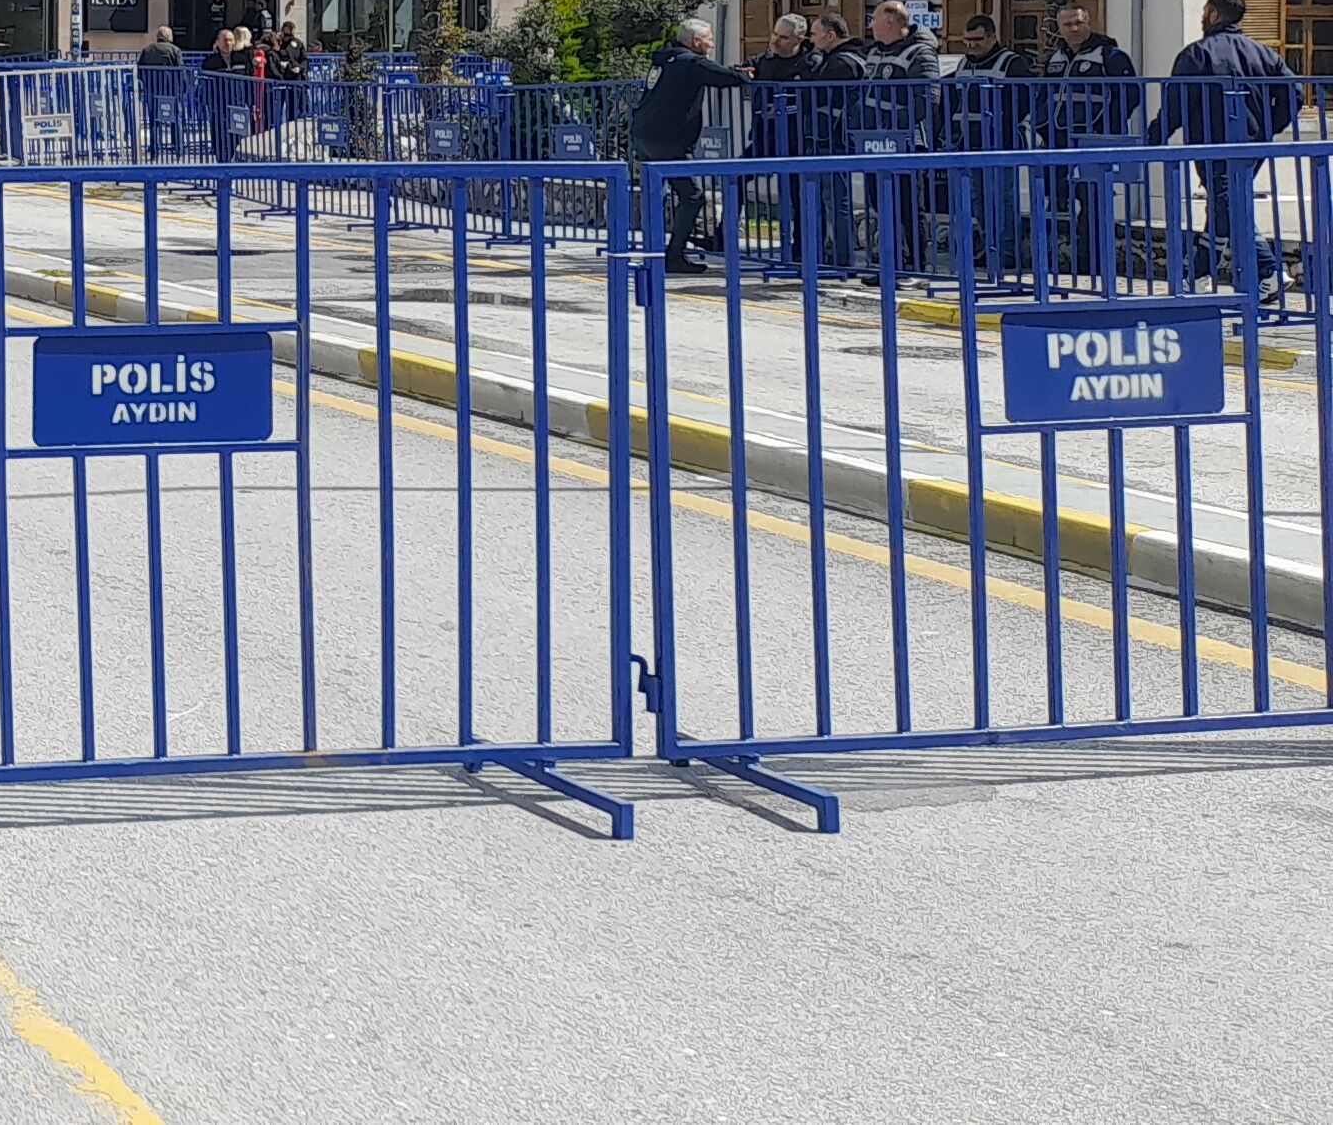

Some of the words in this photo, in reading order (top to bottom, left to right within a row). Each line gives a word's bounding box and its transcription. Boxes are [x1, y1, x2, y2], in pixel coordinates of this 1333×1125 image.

[864, 137, 897, 153] POLİS
[1047, 321, 1181, 369] POLİS
[91, 354, 215, 395] POLİS
[1070, 373, 1163, 401] AYDIN
[112, 401, 196, 424] AYDIN
